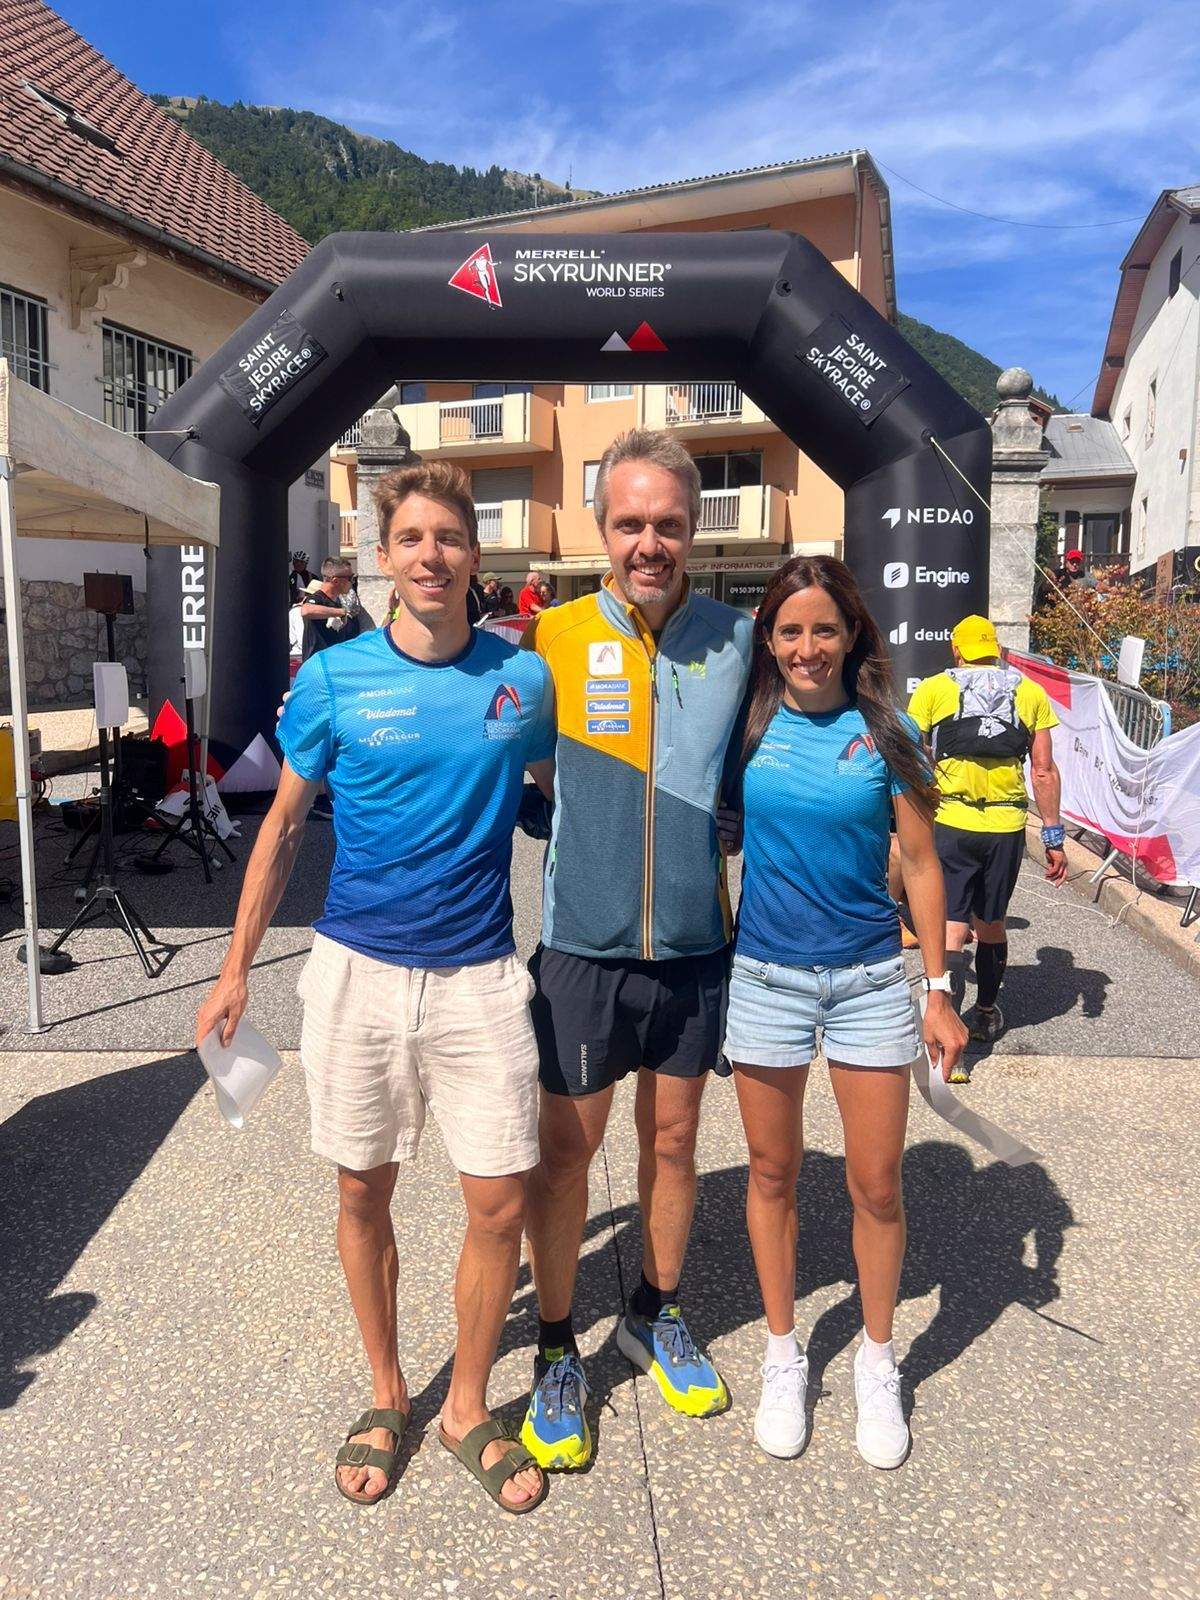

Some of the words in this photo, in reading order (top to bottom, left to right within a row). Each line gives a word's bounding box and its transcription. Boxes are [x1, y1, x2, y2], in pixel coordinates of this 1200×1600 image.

[515, 250, 602, 259] MERRELL
[586, 287, 626, 297] WORLD
[629, 287, 665, 297] SERIES
[239, 333, 276, 372] SAINT
[248, 344, 292, 390] JEOIRE
[828, 345, 876, 389] JEOIRE
[846, 334, 887, 371] SAINT
[907, 508, 974, 525] NEDAO
[710, 561, 774, 570] INFORMATIQUE
[916, 567, 970, 588] Engine
[181, 545, 206, 649] ERRE
[580, 1043, 588, 1086] SALOMON
